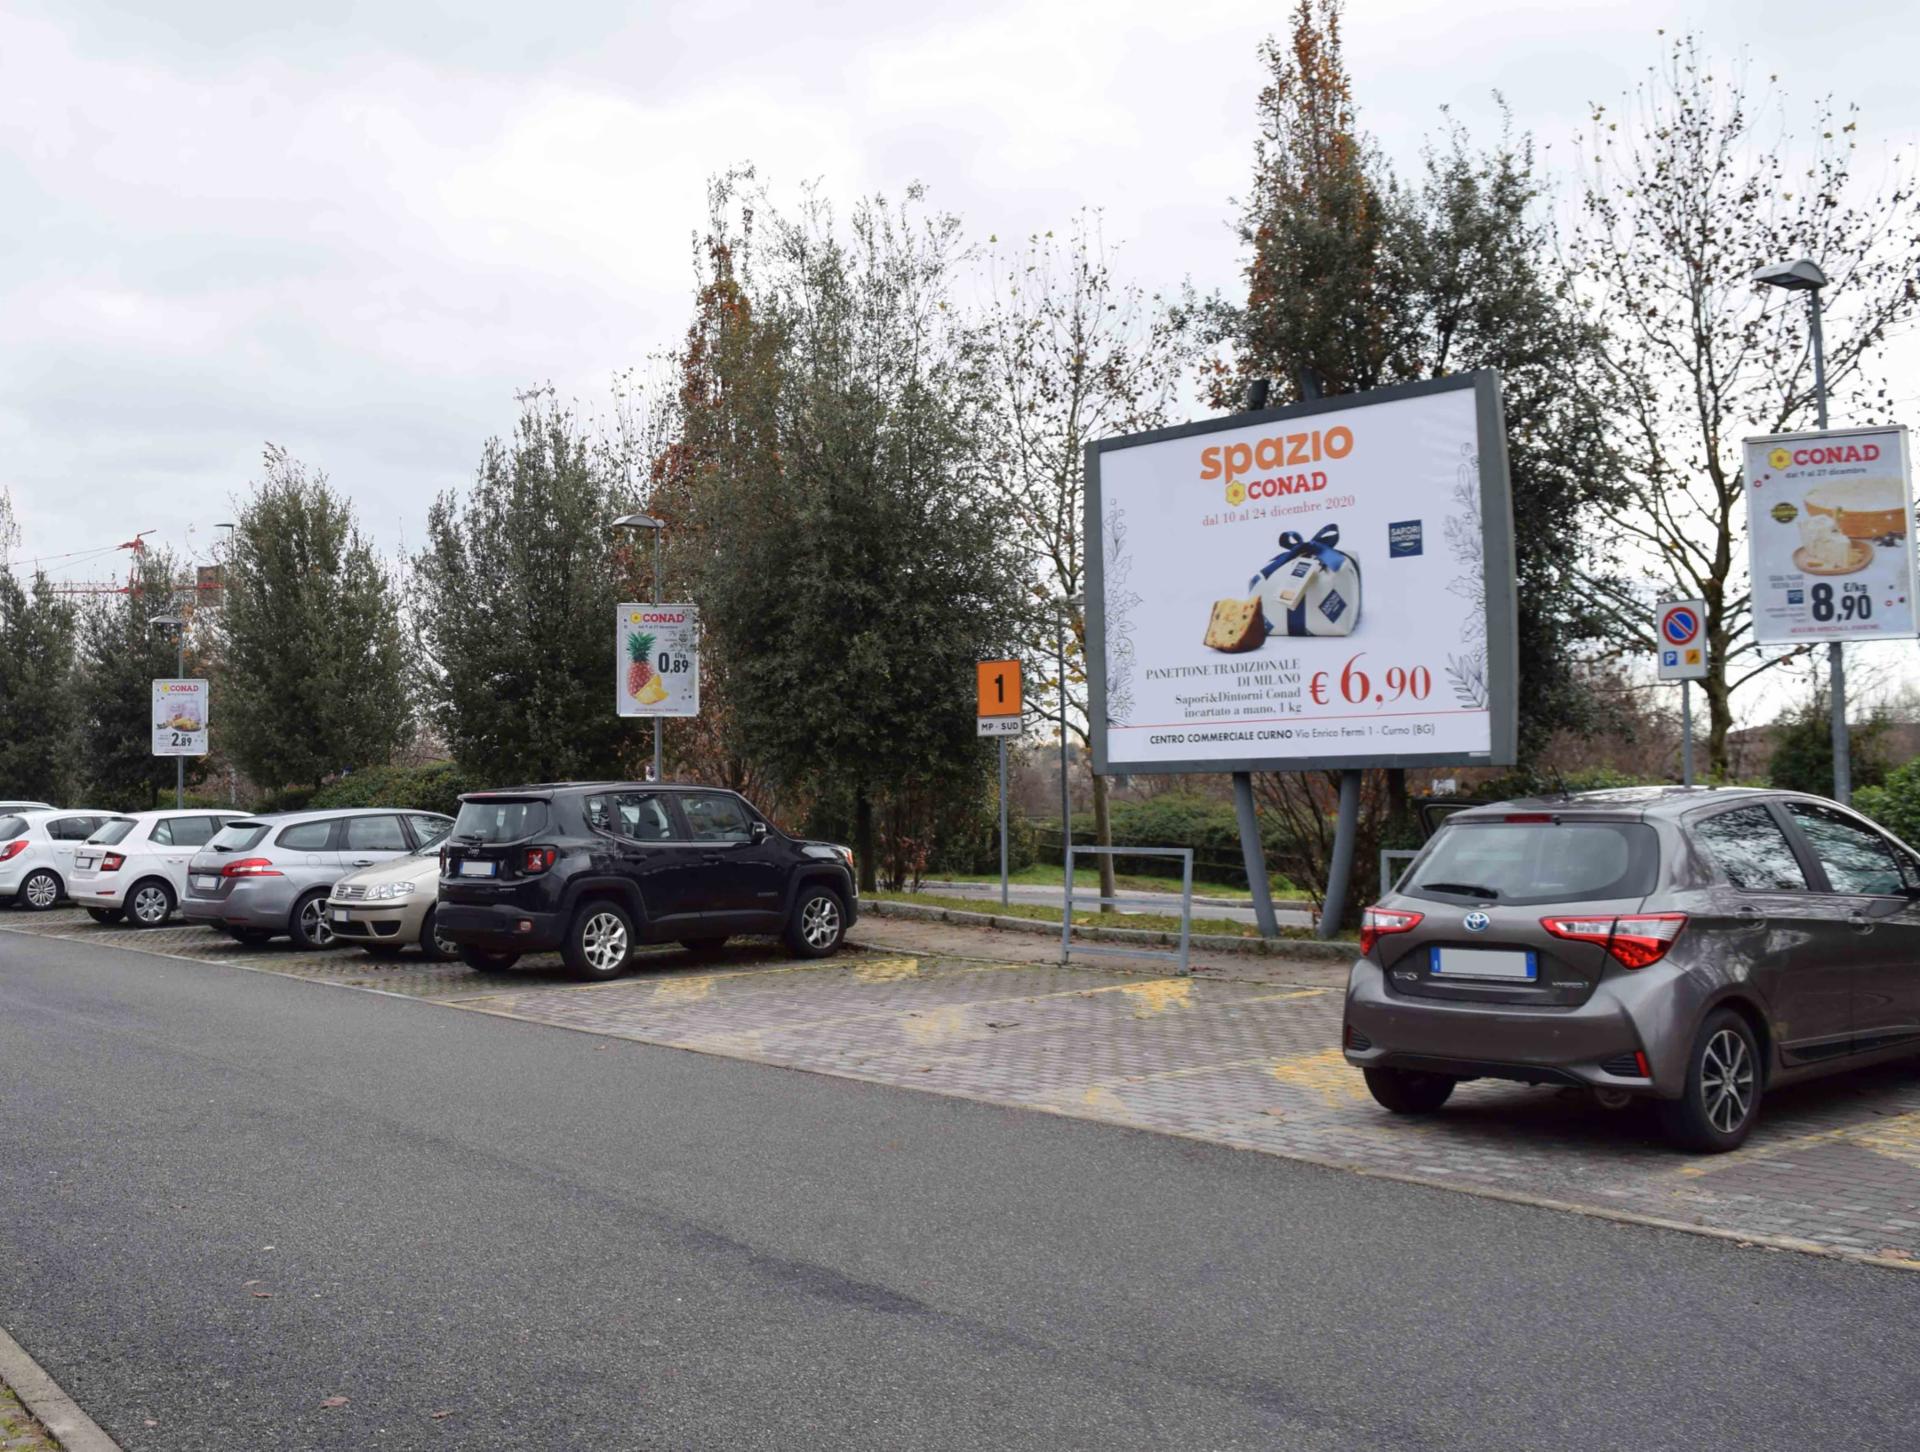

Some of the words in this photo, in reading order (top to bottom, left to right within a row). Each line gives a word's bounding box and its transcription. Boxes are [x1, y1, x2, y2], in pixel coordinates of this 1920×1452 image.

[1200, 426, 1354, 484] spazio
[1793, 444, 1880, 466] CONAD
[1248, 471, 1327, 500] CONAD
[1202, 513, 1219, 526] dal
[1223, 511, 1236, 524] 10
[1239, 509, 1249, 521] al
[1253, 507, 1267, 520] 24
[1270, 501, 1322, 518] dicembre
[1325, 495, 1355, 510] 2020
[1811, 582, 1872, 623] 8,90
[643, 613, 685, 623] CONAD
[658, 652, 689, 673] 0,89
[1146, 665, 1212, 680] PANETTONE
[1213, 658, 1300, 675] TRADIZIONALE
[1666, 652, 1675, 664] P
[170, 684, 199, 692] CONAD
[994, 673, 1004, 703] 1
[1237, 676, 1250, 687] DI
[1254, 673, 1301, 686] MILANO
[1309, 671, 1330, 705] €
[1340, 651, 1431, 710] 6,90
[1266, 687, 1301, 699] Conad
[1184, 704, 1231, 718] incartato
[1280, 702, 1284, 713] 1
[1288, 701, 1303, 713] kg
[981, 723, 994, 731] MP
[1001, 722, 1019, 730] SUD
[1150, 734, 1185, 745] CENTRO
[1187, 731, 1254, 743] COMMERCIALE
[1257, 729, 1293, 740] CURNO
[1295, 729, 1310, 738] Via
[1312, 728, 1339, 738] Enrico
[1341, 727, 1366, 737] Fermi
[1368, 726, 1373, 735] 1
[1382, 725, 1410, 736] Curno
[1412, 723, 1436, 736] (BG)
